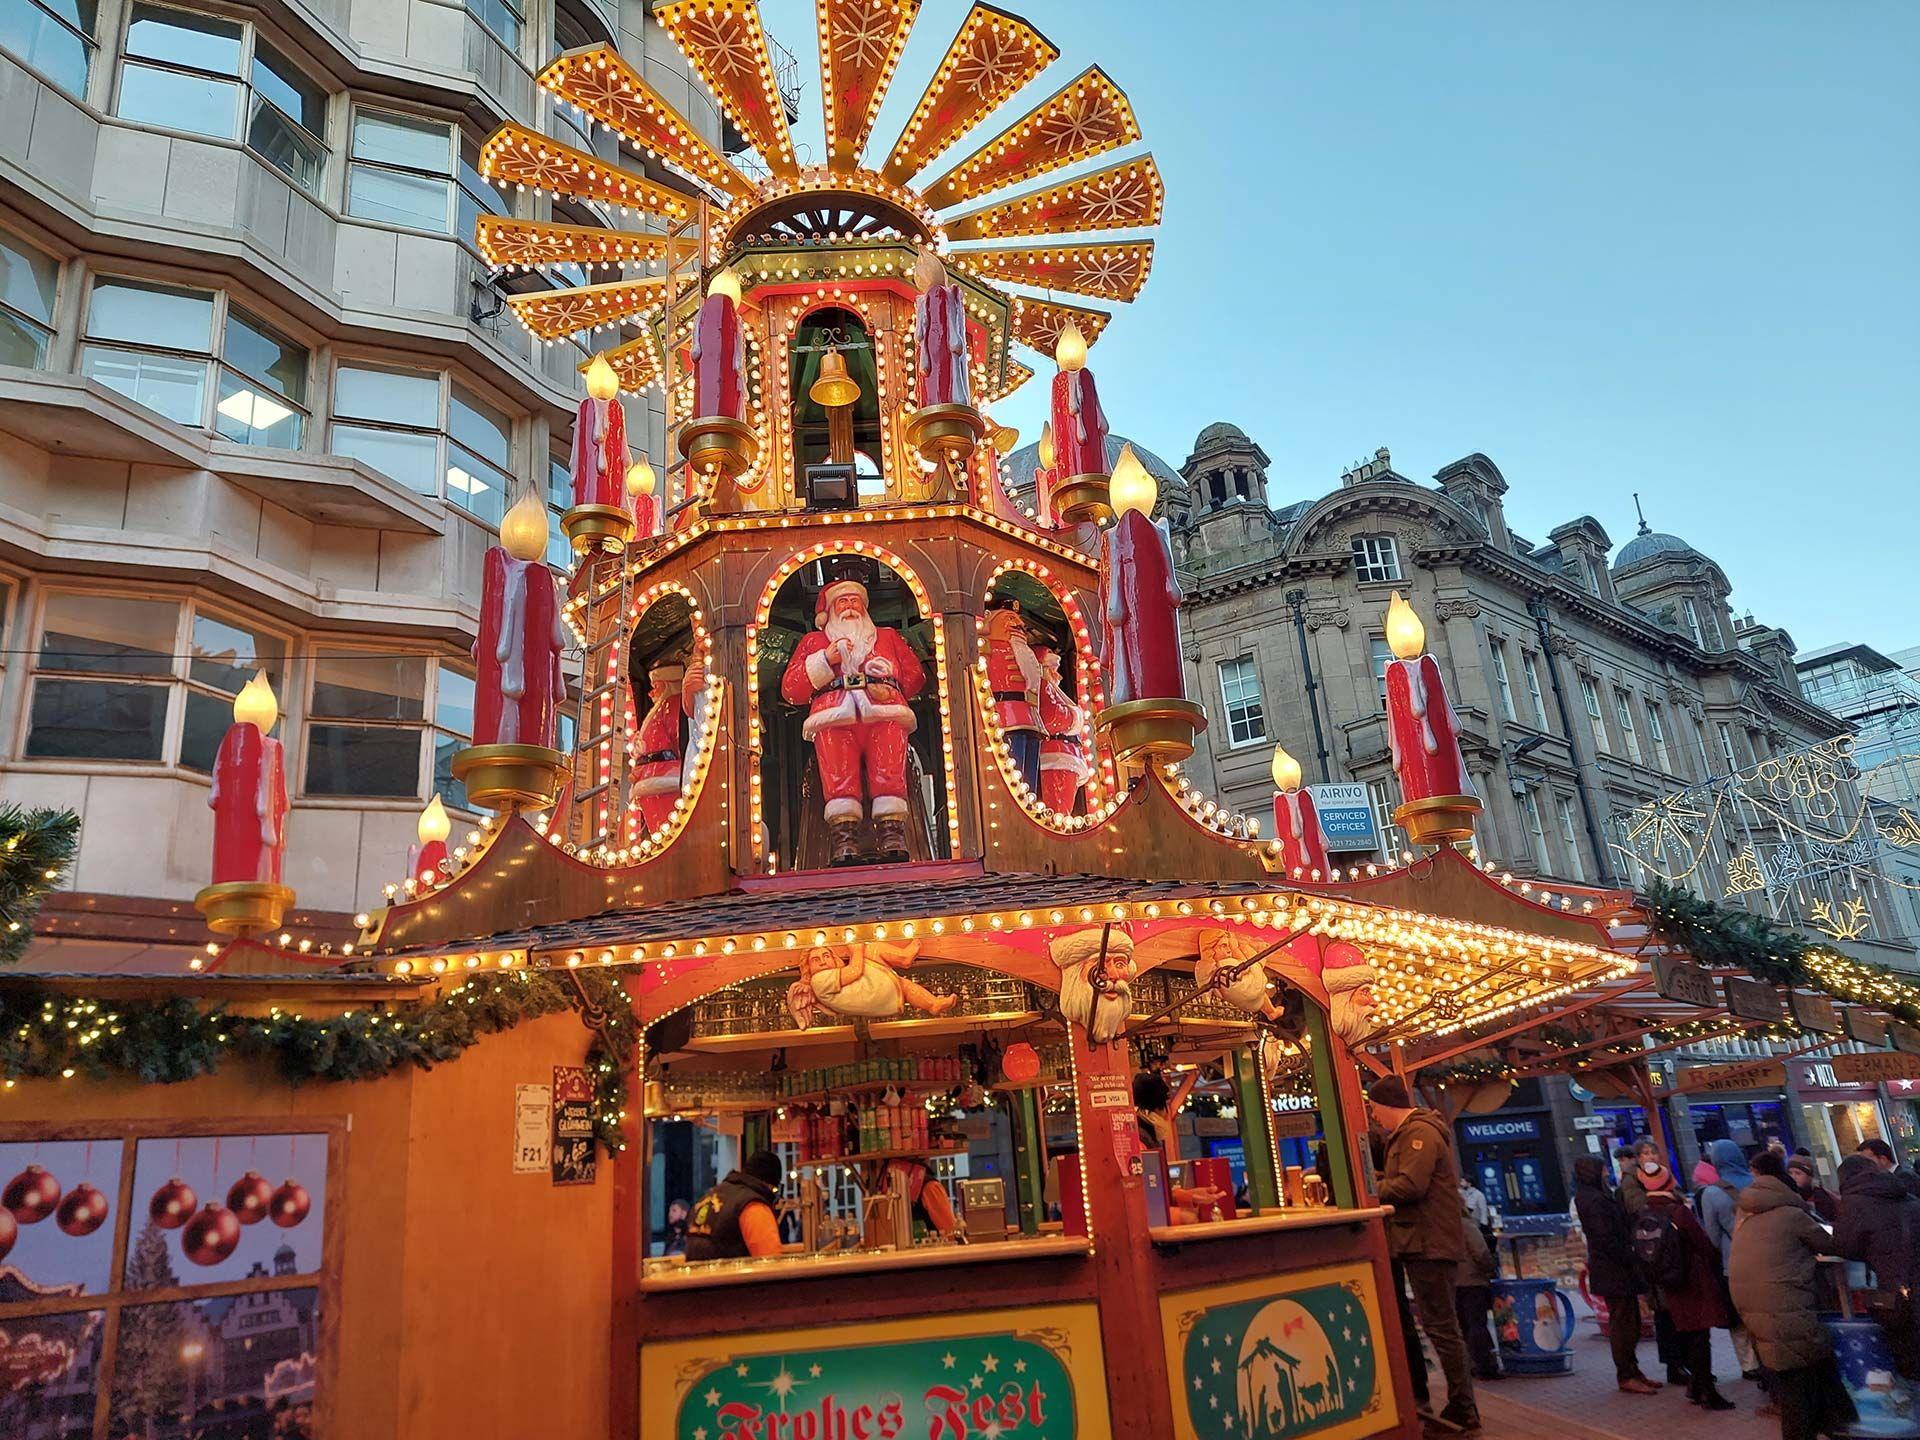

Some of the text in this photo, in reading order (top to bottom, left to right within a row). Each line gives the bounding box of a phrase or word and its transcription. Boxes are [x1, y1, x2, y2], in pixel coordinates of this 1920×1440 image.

[1320, 787, 1362, 799] AIRIVO
[1323, 812, 1366, 821] SERVICED
[1329, 823, 1366, 831] OFFICES
[1704, 1078, 1757, 1090] SHANDY
[1111, 1112, 1135, 1122] UNDER
[1467, 1121, 1534, 1137] WELCOME
[522, 1147, 541, 1162] F21
[1131, 1162, 1144, 1175] 25
[716, 1378, 1047, 1440] Frohes Fest
